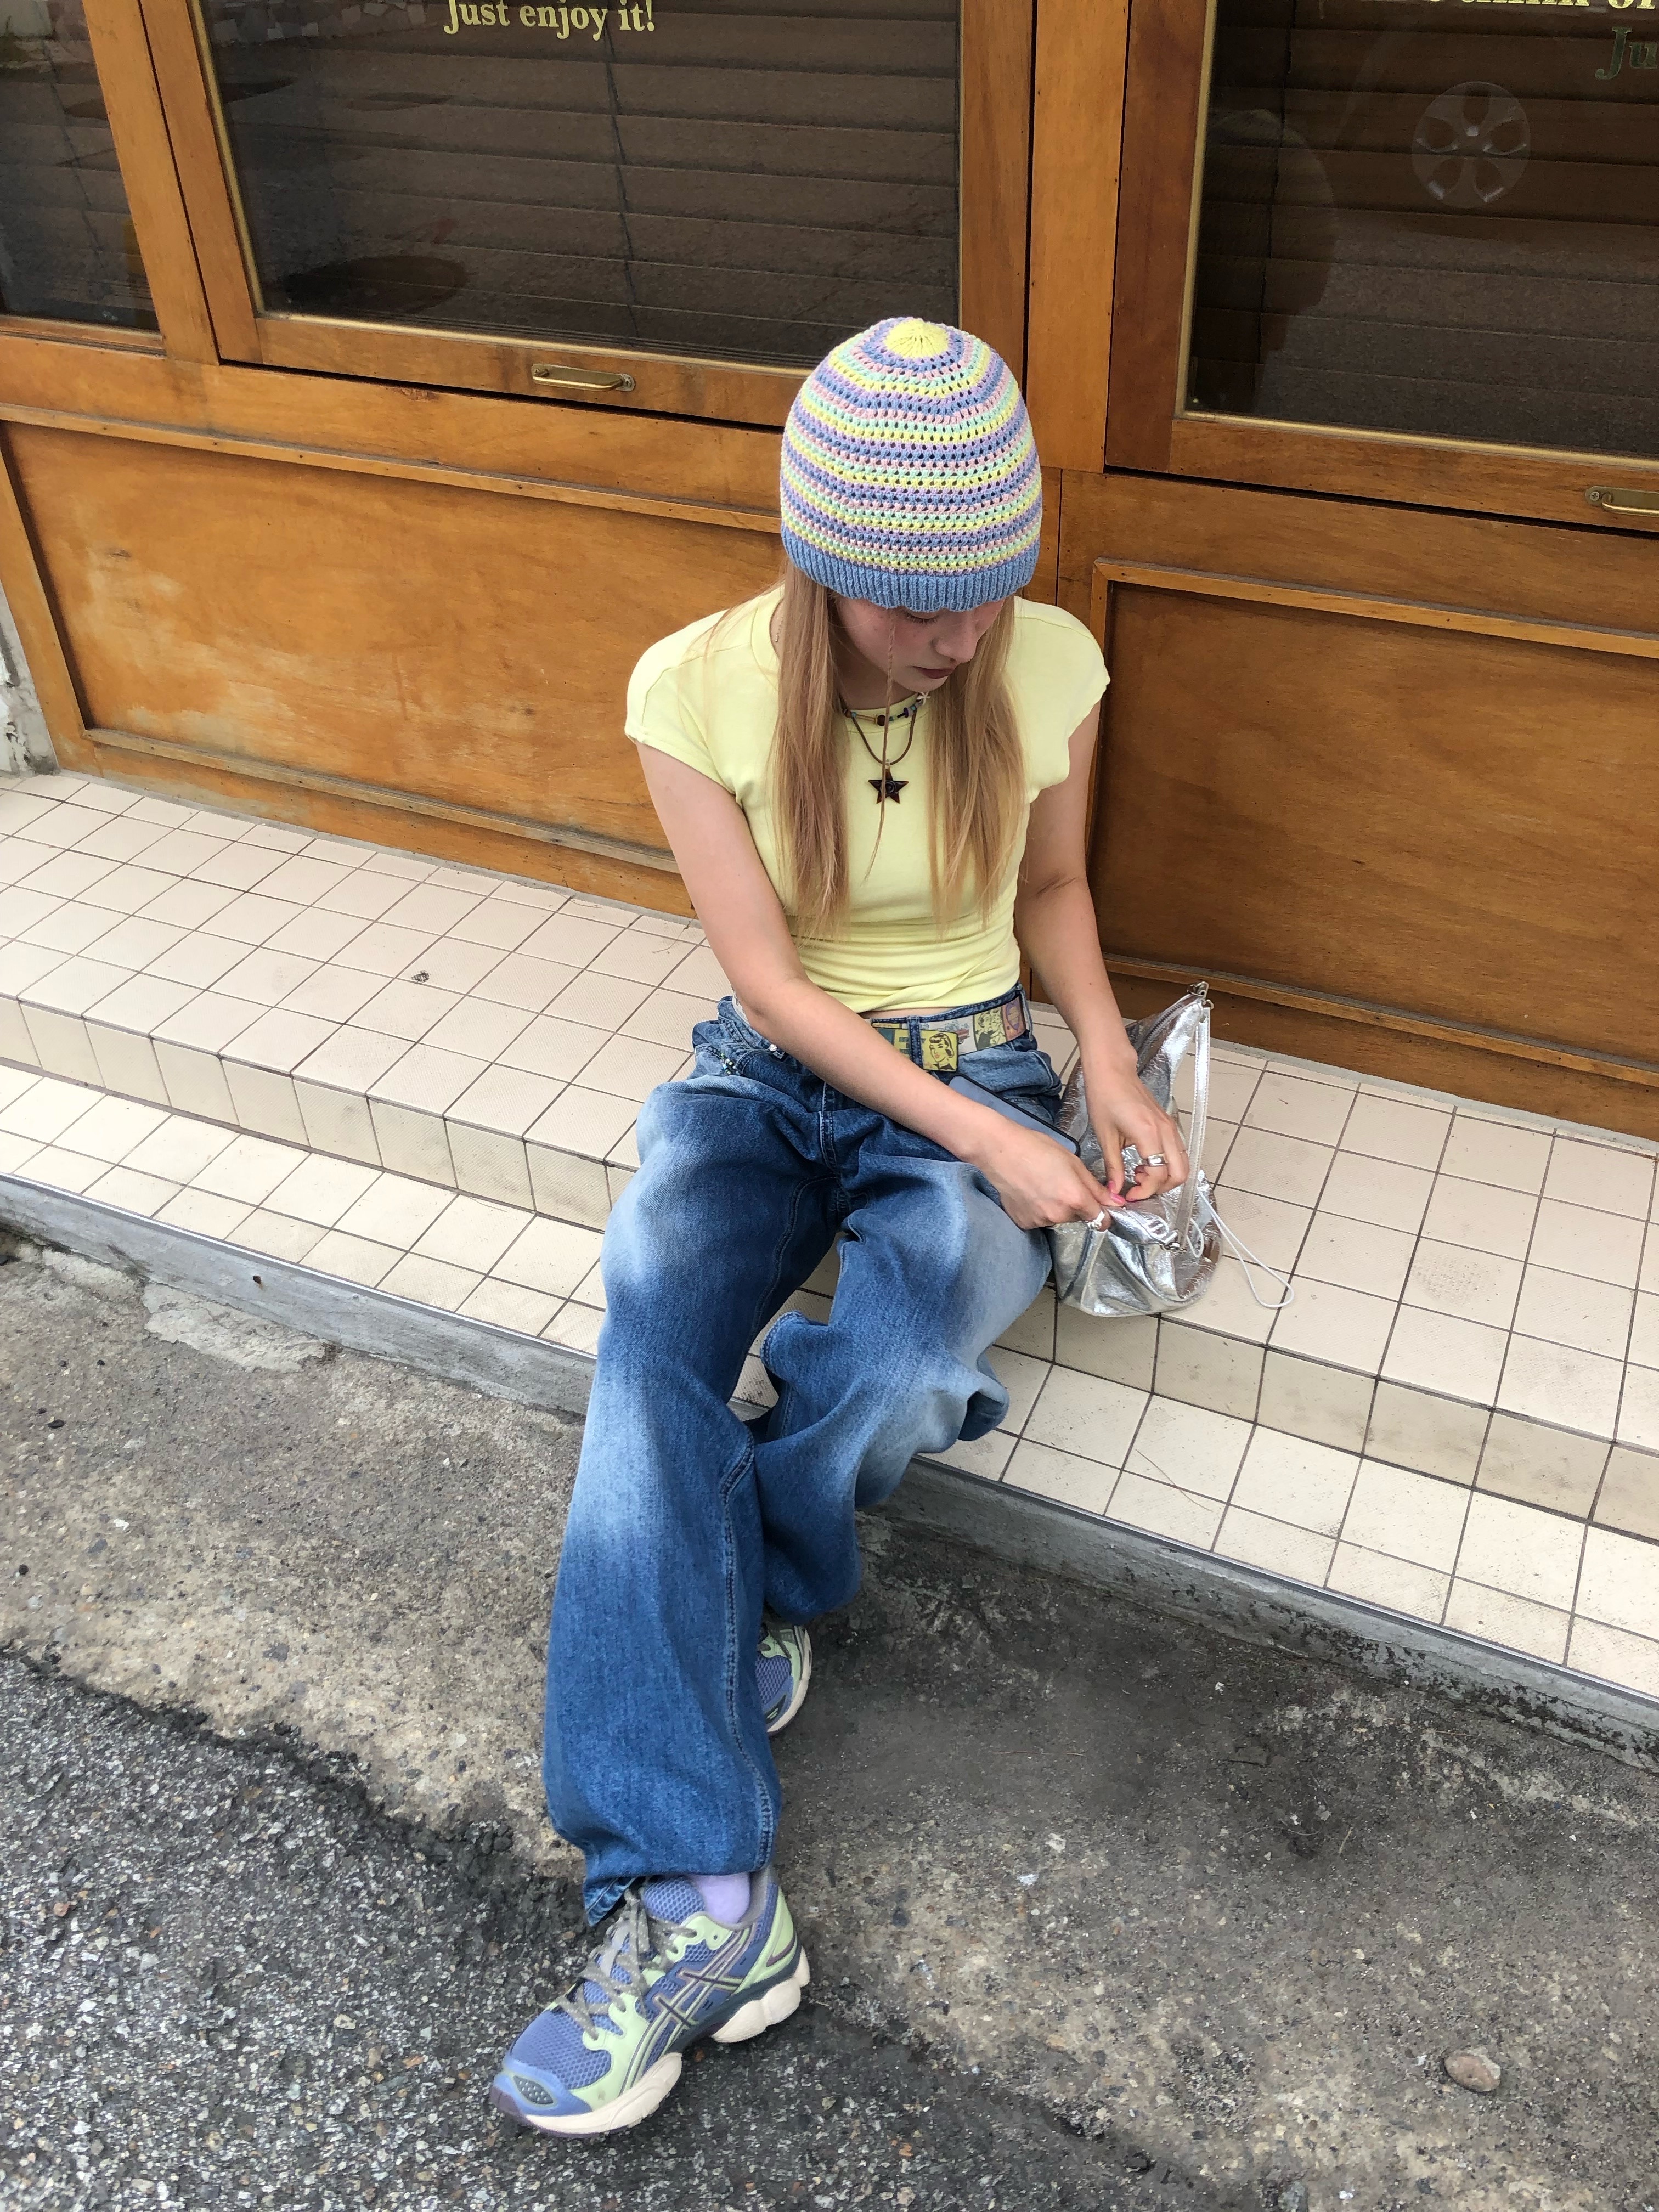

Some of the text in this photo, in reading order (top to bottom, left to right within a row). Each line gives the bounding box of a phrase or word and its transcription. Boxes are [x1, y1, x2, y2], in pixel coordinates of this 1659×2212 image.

[443, 0, 655, 41] Just enjoy it!
